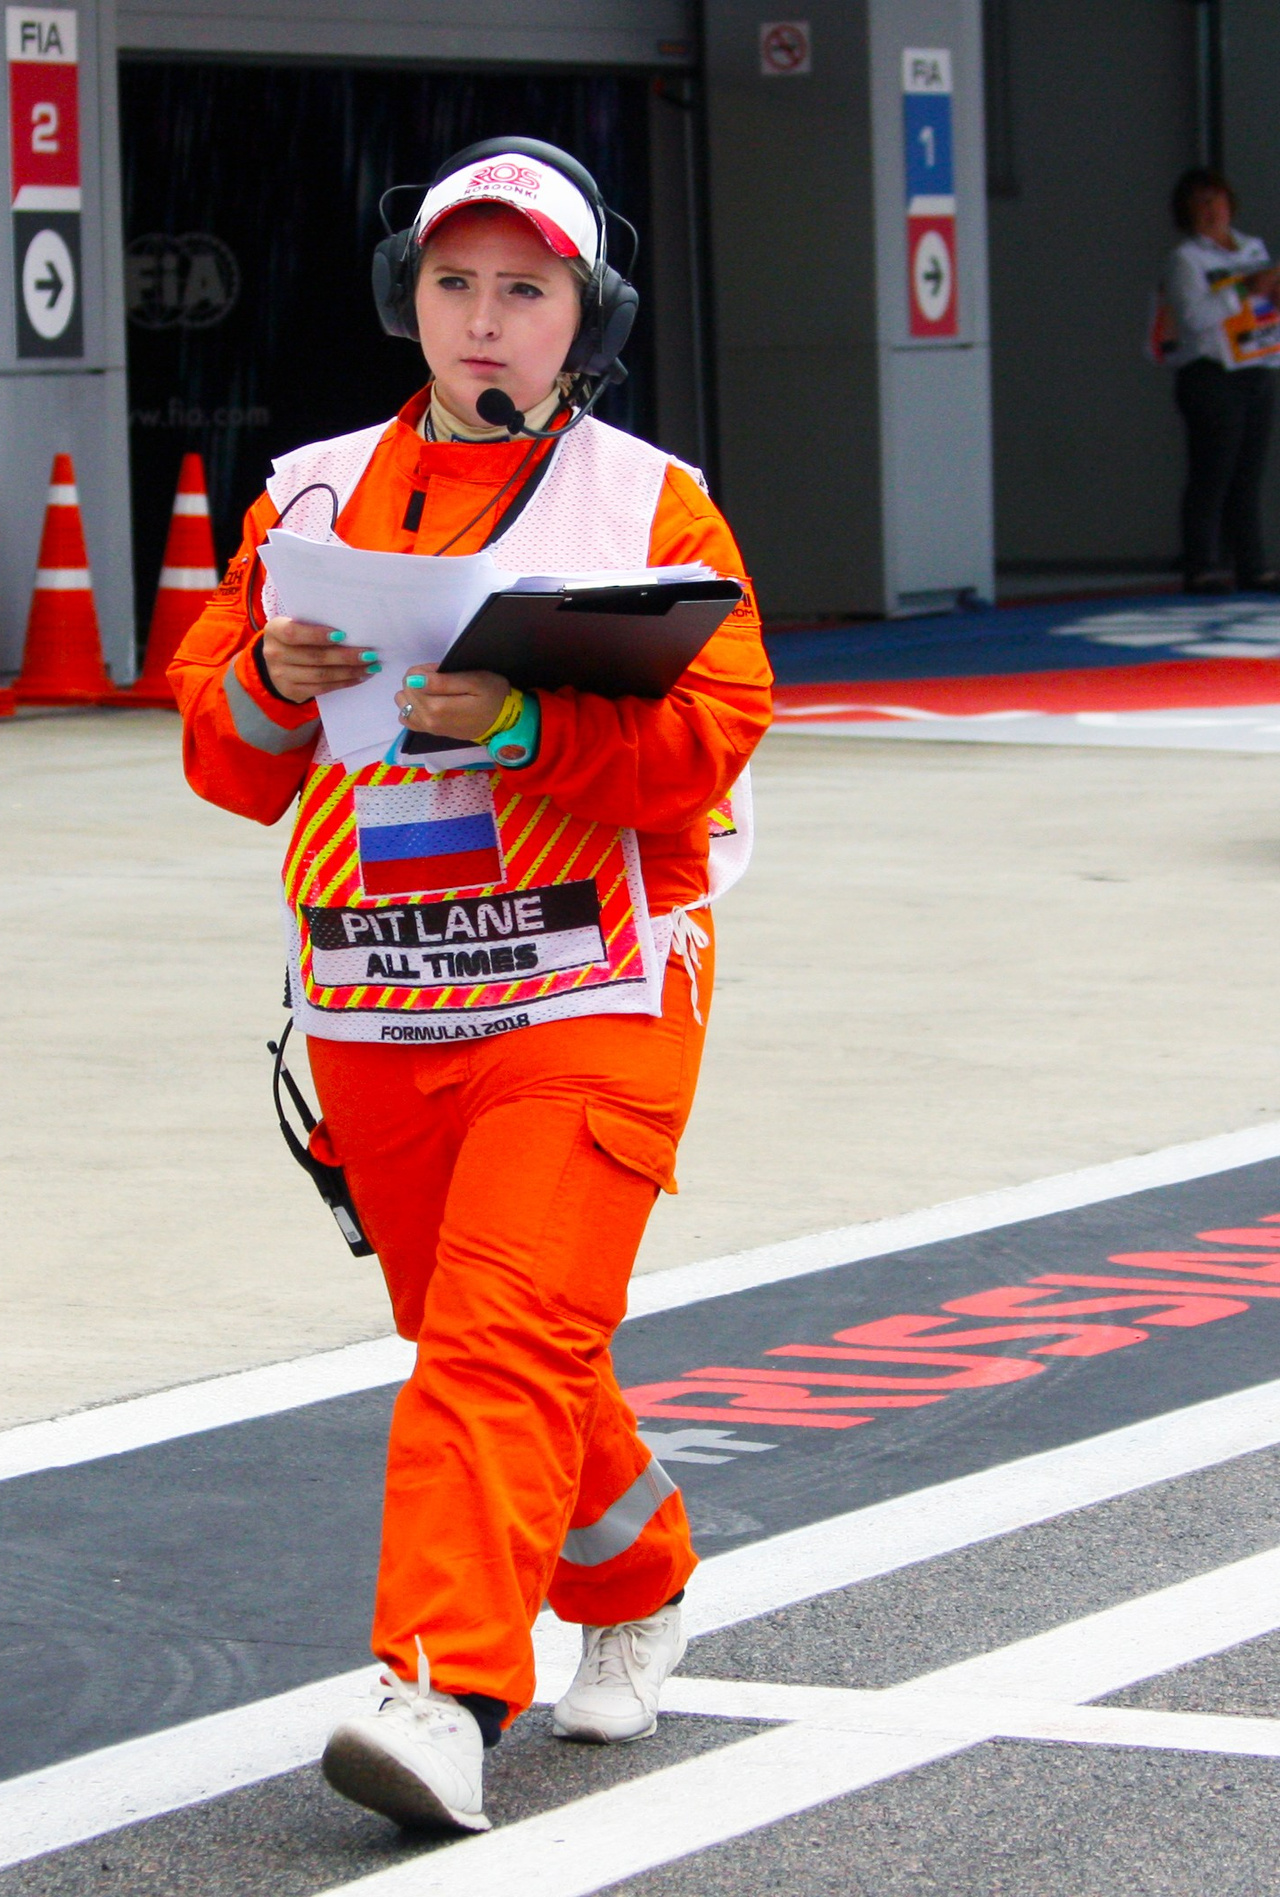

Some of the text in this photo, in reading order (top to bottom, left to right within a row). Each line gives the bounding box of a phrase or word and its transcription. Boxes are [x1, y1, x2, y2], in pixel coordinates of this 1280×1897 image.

[21, 21, 63, 54] FIA
[913, 59, 943, 86] FIA
[31, 102, 59, 153] 2
[919, 125, 936, 168] 1
[467, 162, 541, 191] ROS
[340, 895, 546, 943] PIT LANE
[366, 942, 539, 978] ALL TIMES
[381, 1012, 531, 1041] FORMULA 1 2018
[621, 1213, 1280, 1429] RUSSIA
